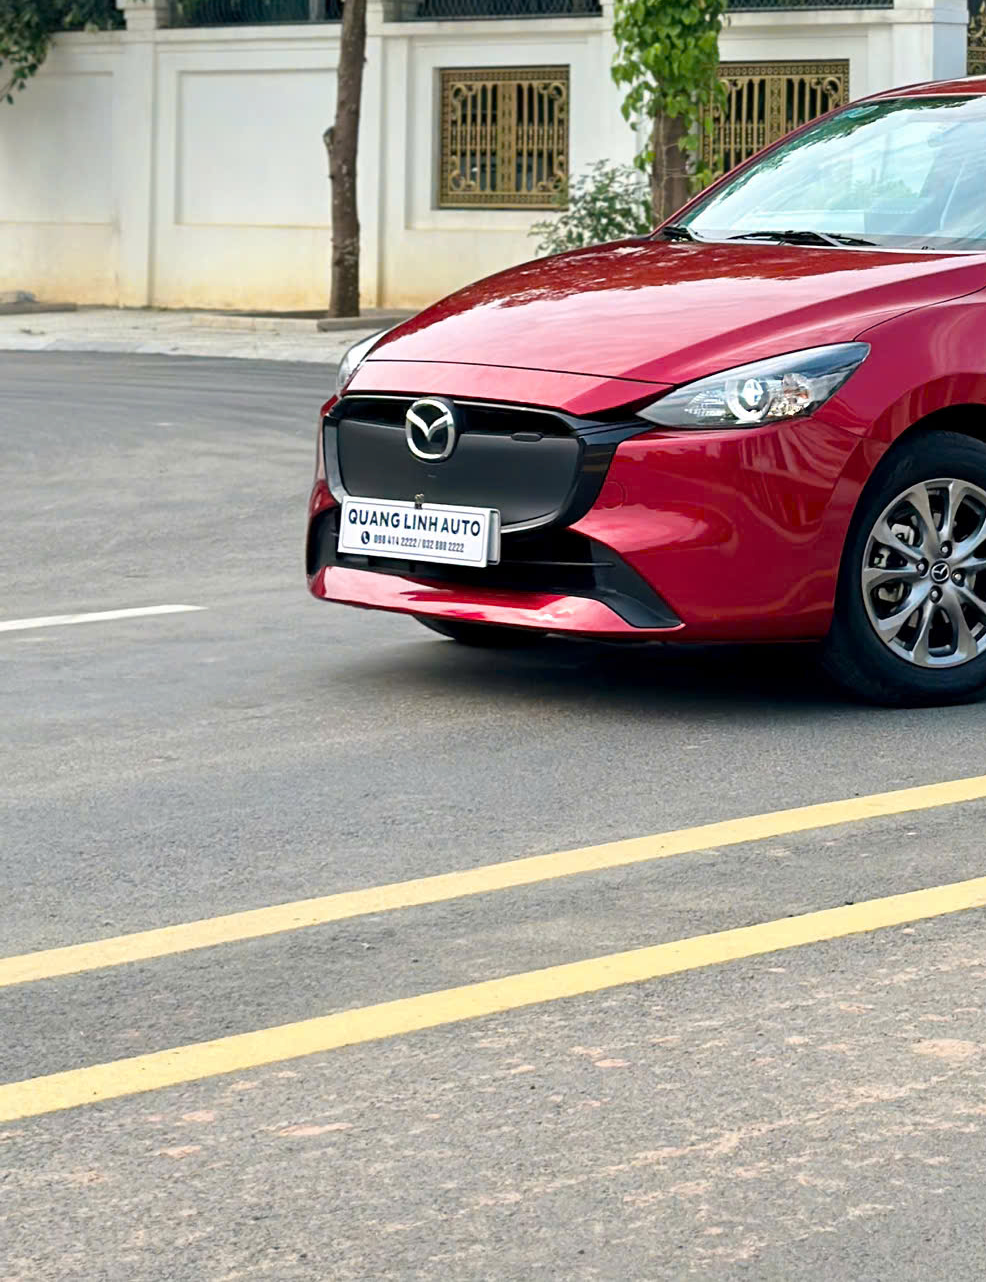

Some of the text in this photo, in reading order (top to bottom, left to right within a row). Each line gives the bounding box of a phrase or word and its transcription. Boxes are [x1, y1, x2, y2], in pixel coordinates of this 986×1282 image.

[348, 508, 481, 537] QUANG LINH AUTO
[401, 537, 417, 548] 2222
[448, 542, 464, 553] 2222
